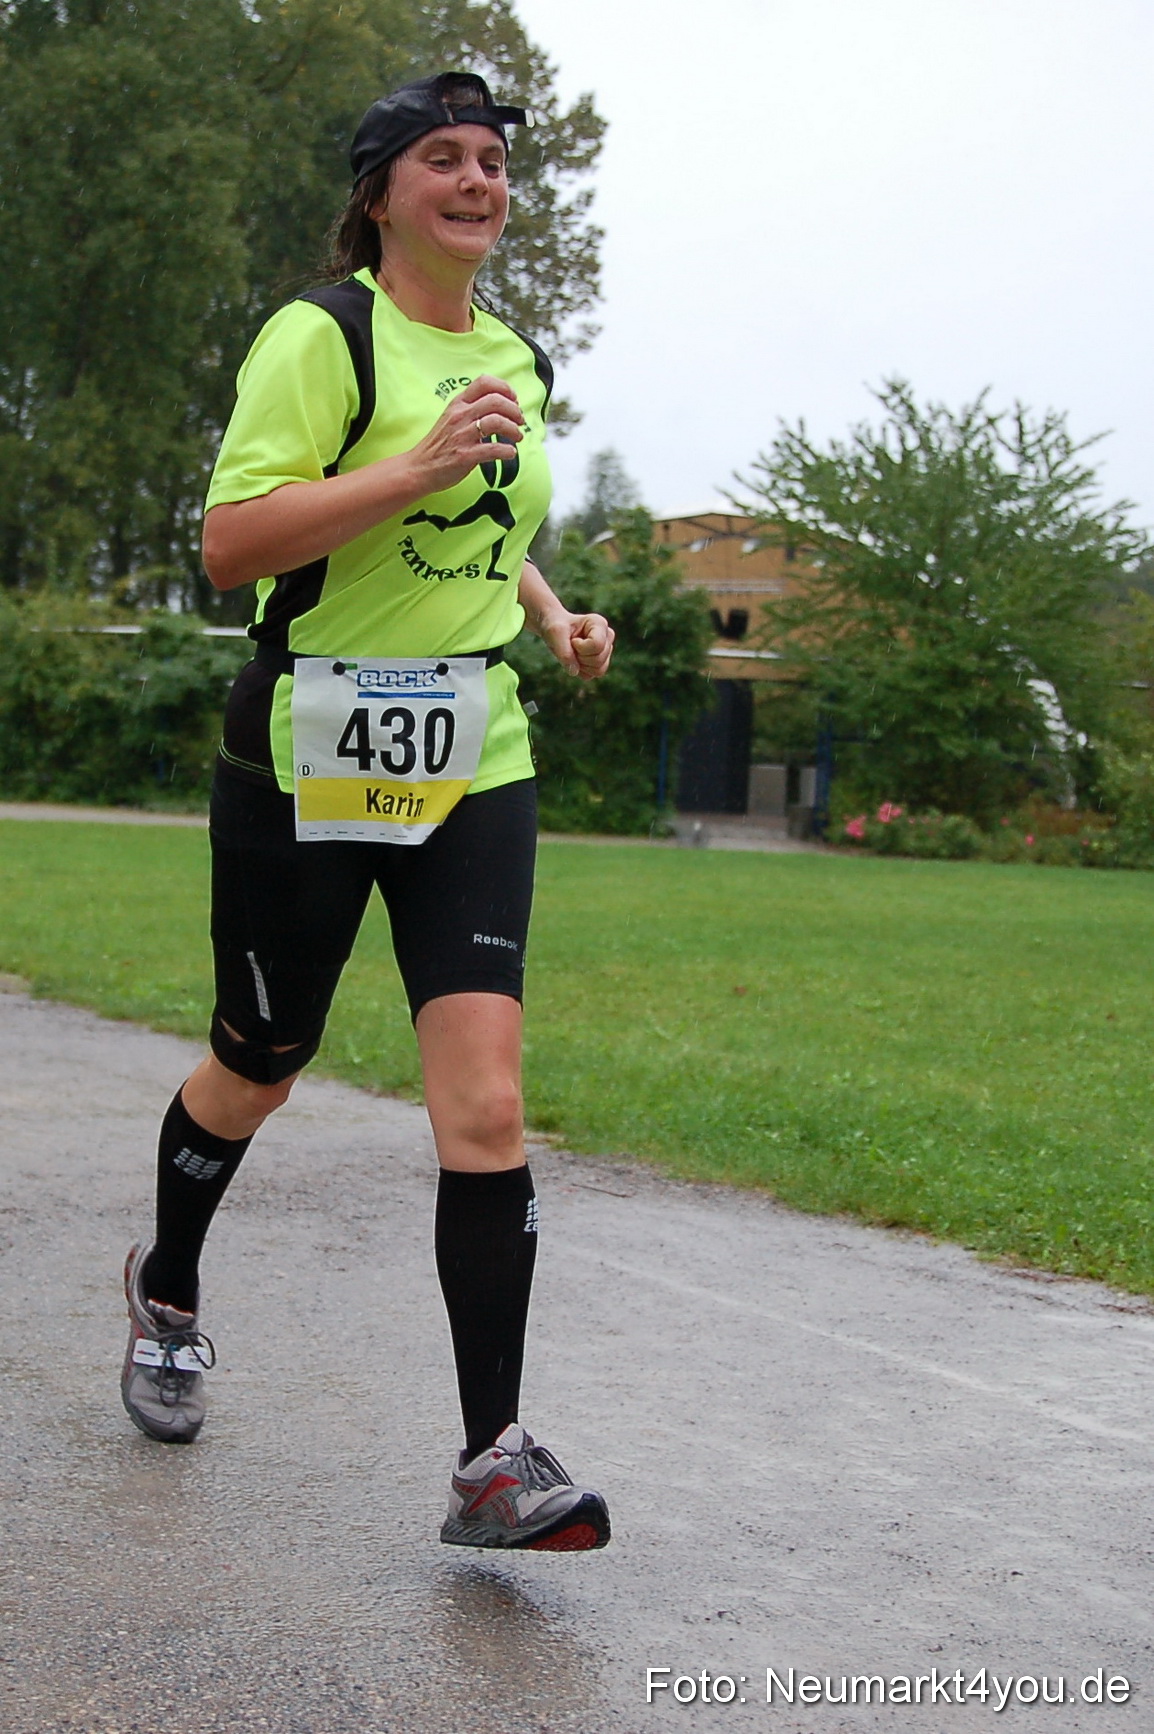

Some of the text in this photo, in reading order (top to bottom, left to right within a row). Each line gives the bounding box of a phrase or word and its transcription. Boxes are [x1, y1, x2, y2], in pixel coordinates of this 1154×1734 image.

[357, 669, 438, 688] BOCK
[336, 707, 456, 776] 430
[302, 764, 310, 777] D
[365, 787, 424, 818] Karin
[473, 933, 518, 952] Reebok
